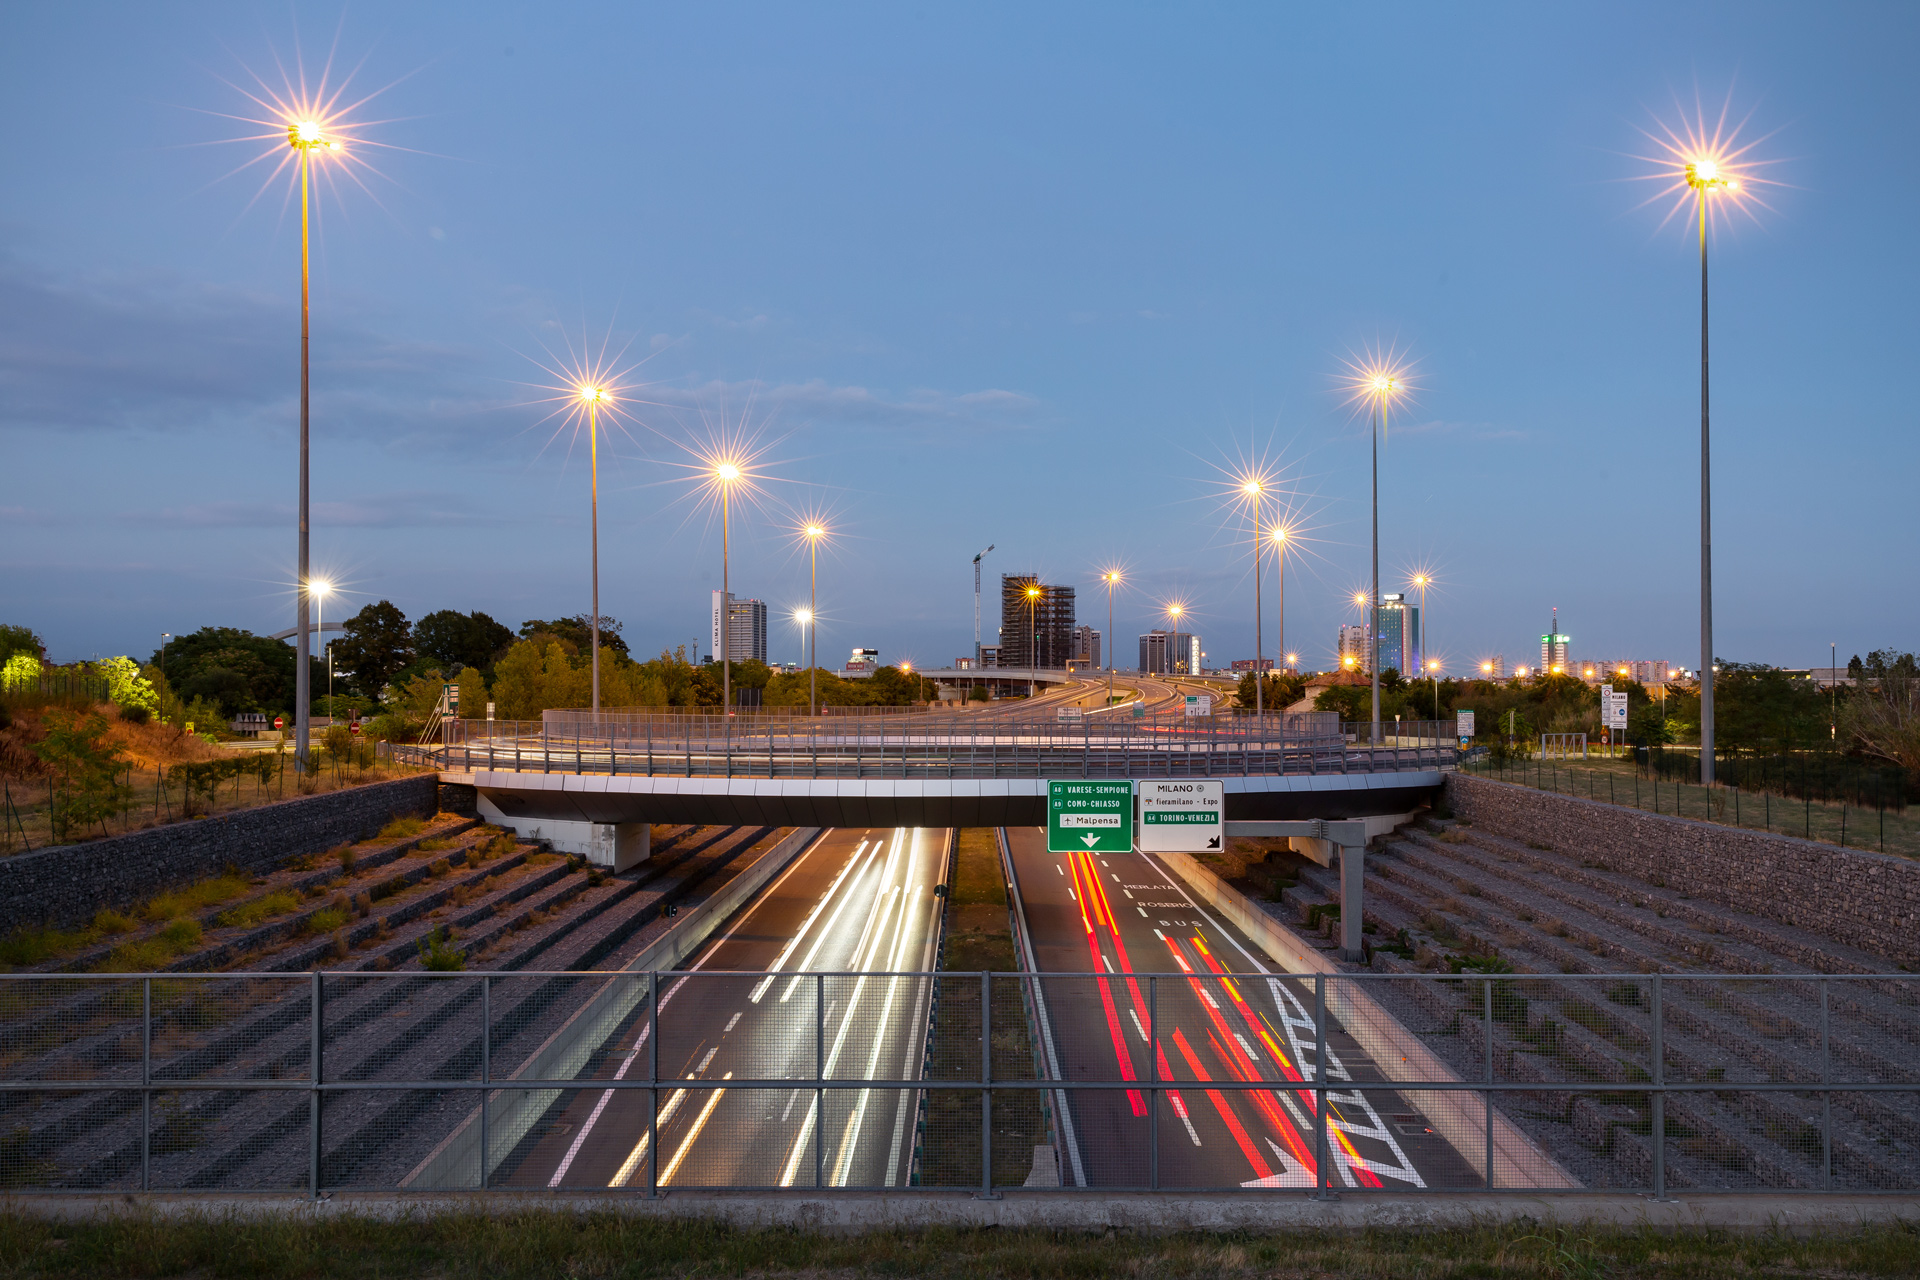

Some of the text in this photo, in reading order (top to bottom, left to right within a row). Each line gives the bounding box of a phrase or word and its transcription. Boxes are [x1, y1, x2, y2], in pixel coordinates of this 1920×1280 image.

[1067, 786, 1129, 794] VARESE-SEMPIONE
[1157, 785, 1193, 793] MILANO
[1067, 800, 1120, 808] COMO-CHIASSO
[1203, 798, 1219, 806] Expo
[1076, 817, 1119, 825] Malpensa
[1159, 814, 1216, 822] TORINO-VENEZIA
[1137, 901, 1193, 909] ROSERIO
